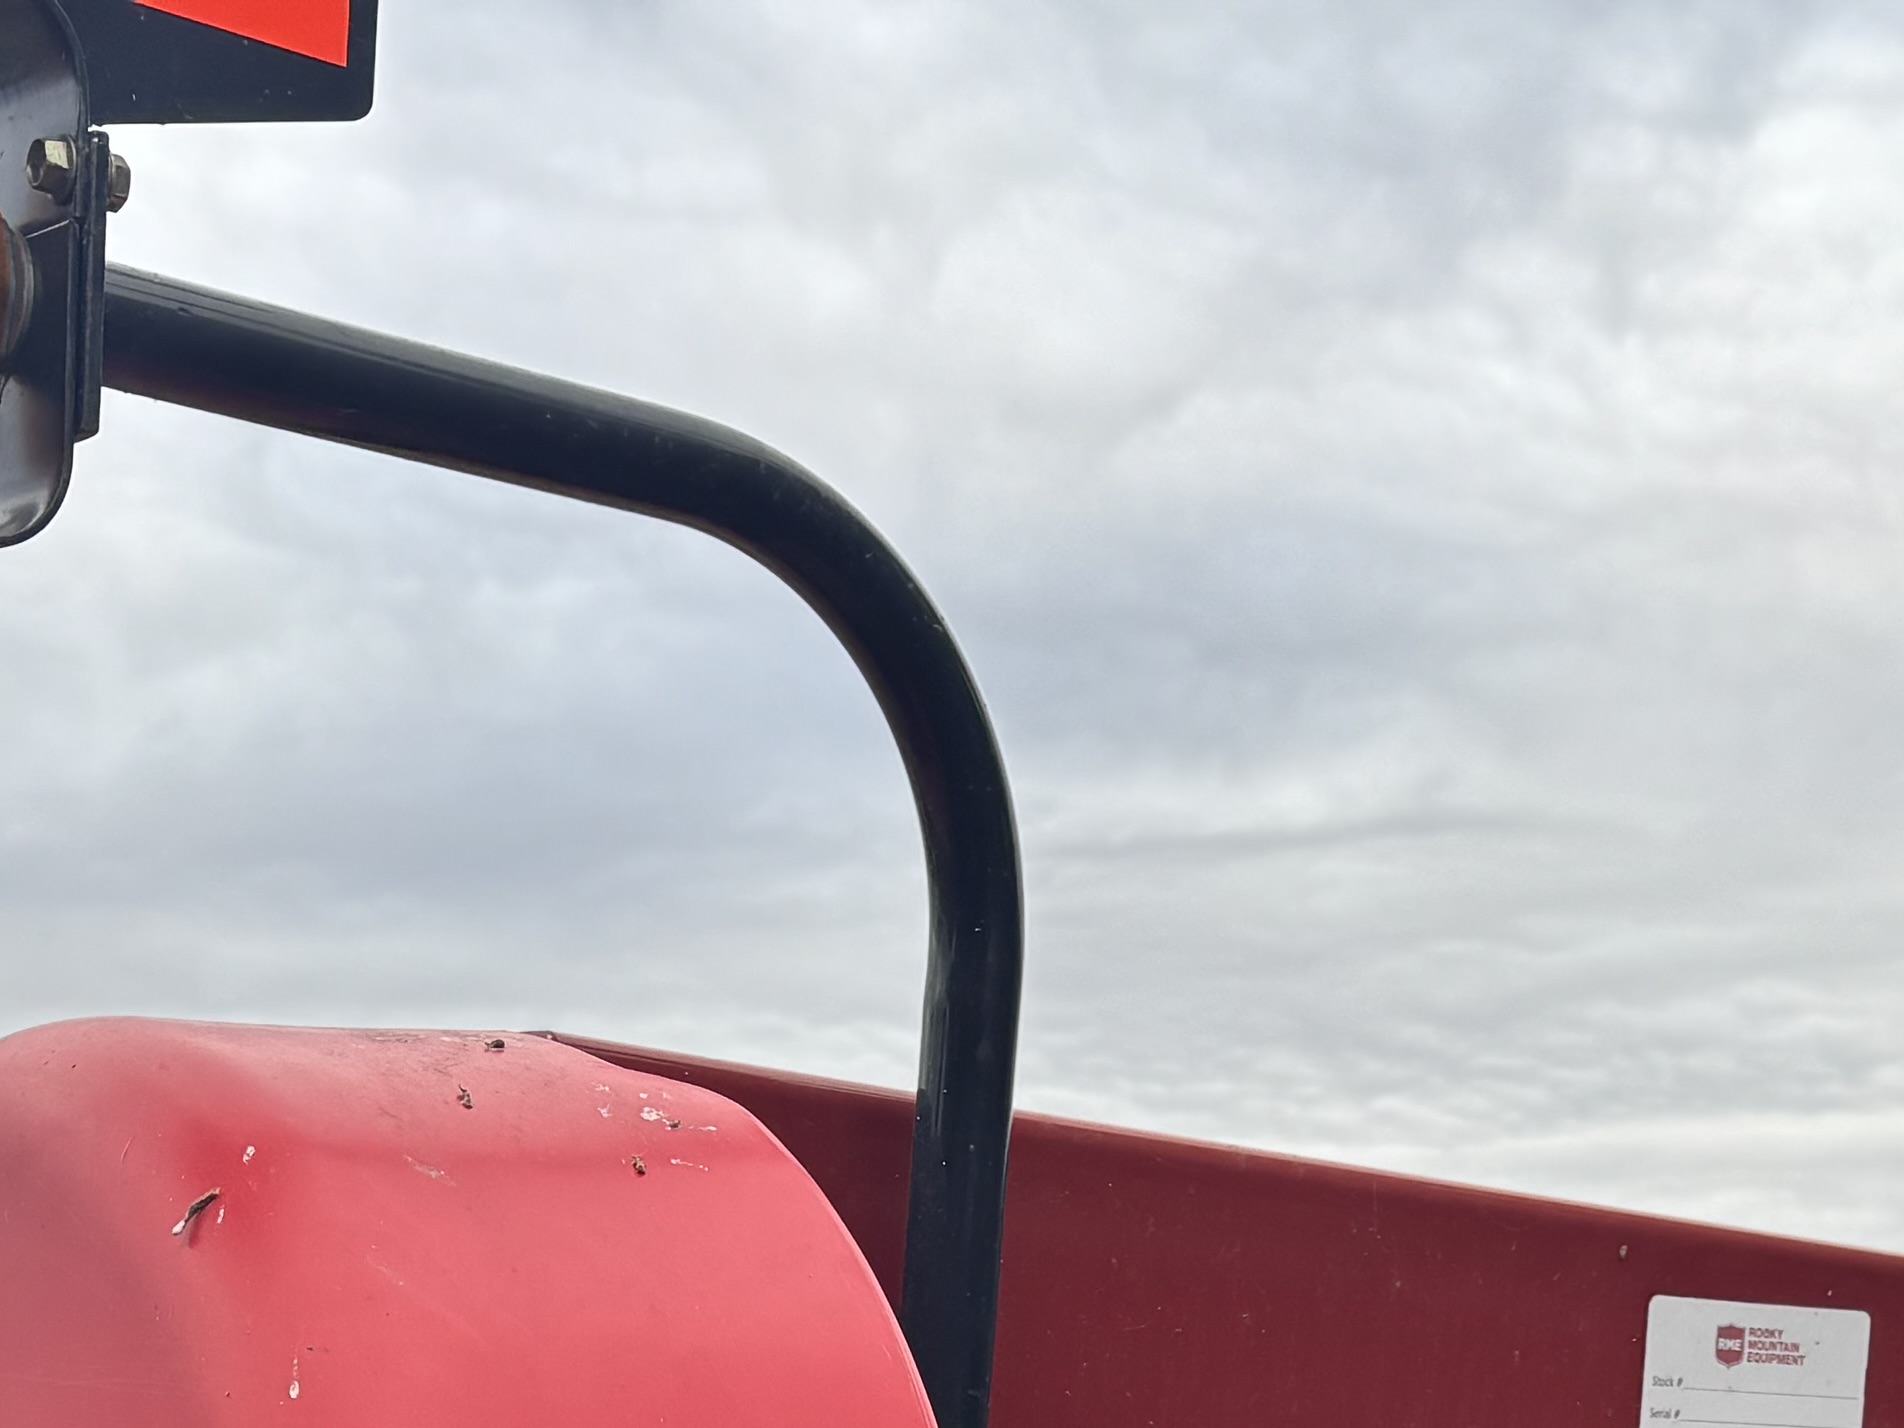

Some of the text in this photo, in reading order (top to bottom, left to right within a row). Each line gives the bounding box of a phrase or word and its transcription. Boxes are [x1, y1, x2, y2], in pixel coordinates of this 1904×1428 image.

[1748, 1327, 1784, 1340] ROCKY
[1747, 1339, 1800, 1353] MOUNTAIN
[1746, 1351, 1806, 1366] EQUIPMENT
[1652, 1375, 1674, 1387] Stock
